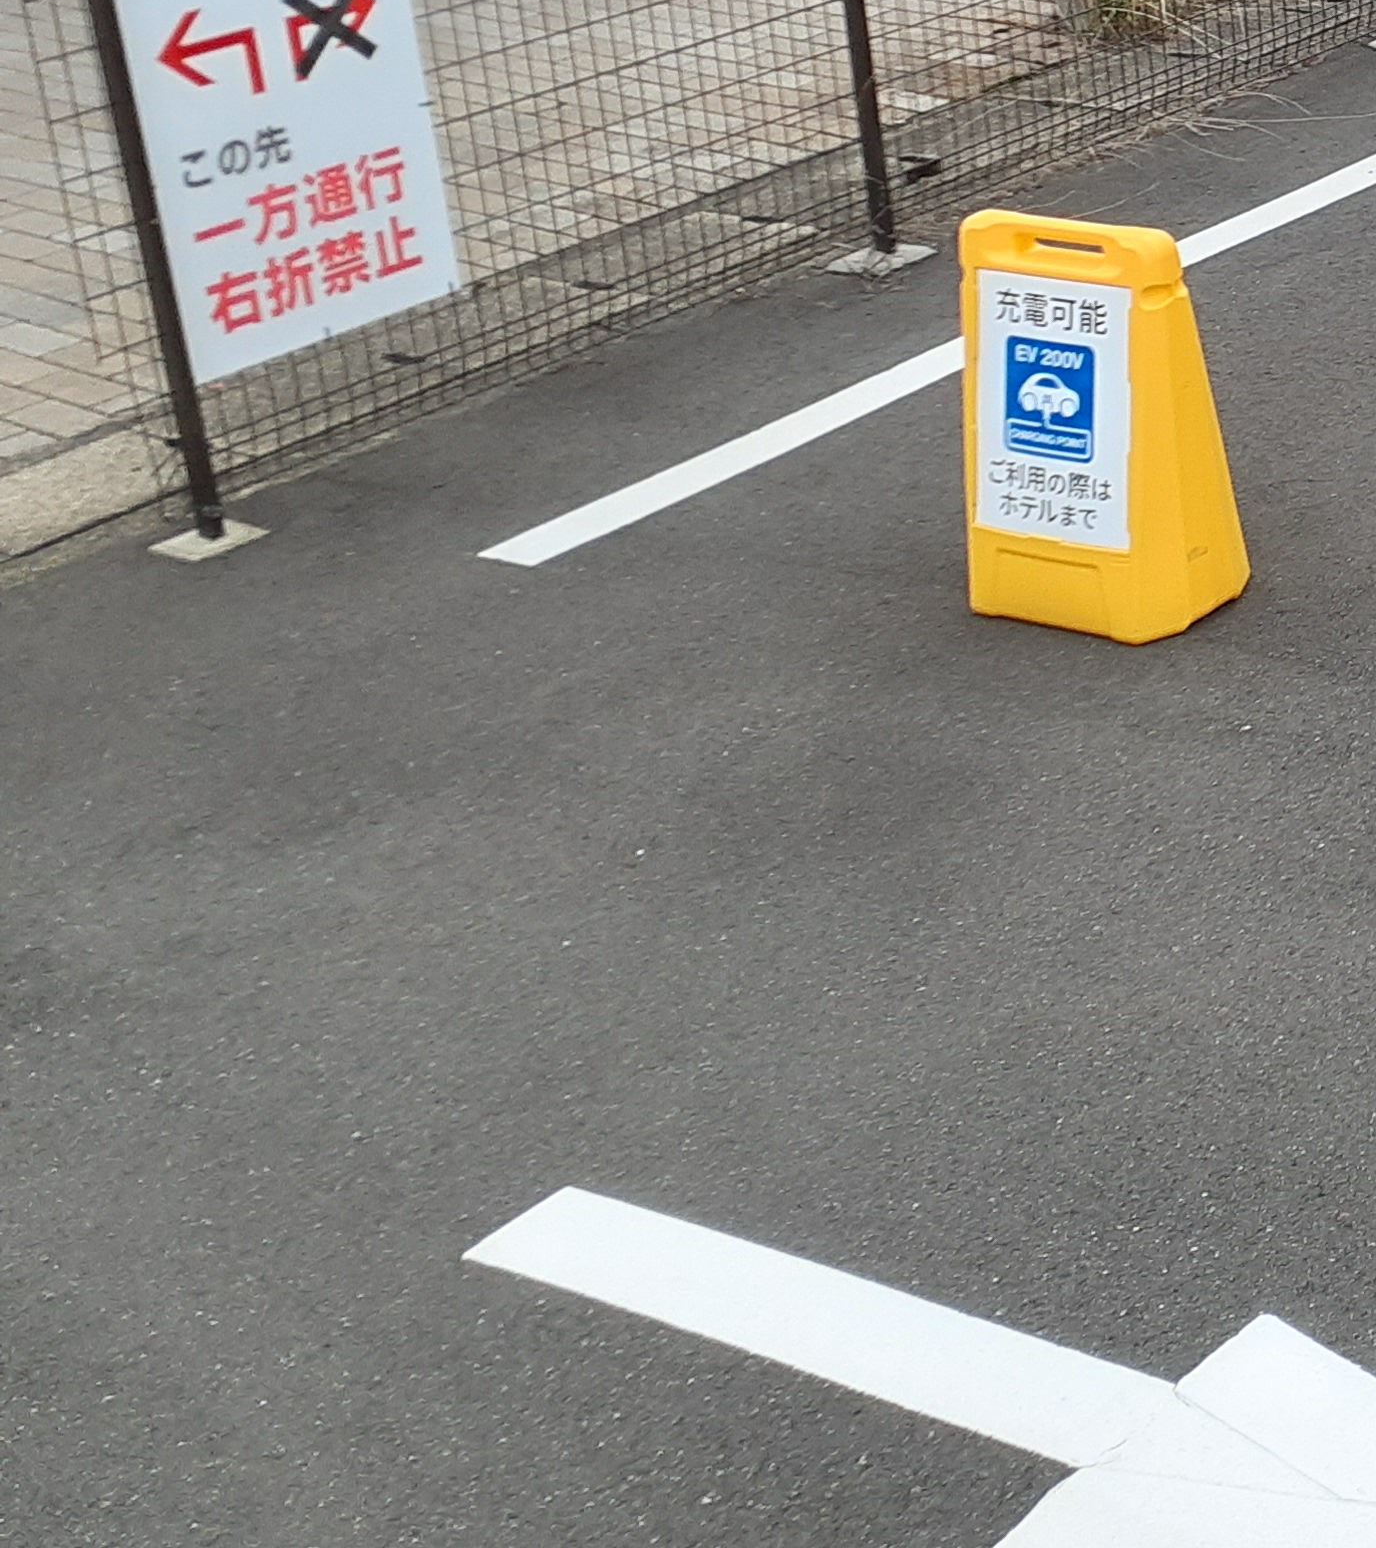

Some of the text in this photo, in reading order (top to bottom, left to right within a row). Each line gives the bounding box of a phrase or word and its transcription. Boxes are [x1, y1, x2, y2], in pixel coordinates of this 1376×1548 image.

[181, 126, 293, 189] この先
[194, 146, 405, 245] 一方通行
[206, 216, 424, 334] 右折禁止
[995, 287, 1108, 335] 充電可能
[1014, 343, 1085, 370] EV 200V
[988, 459, 1112, 502] ご利用の際は
[999, 491, 1098, 530] ホテルまで
